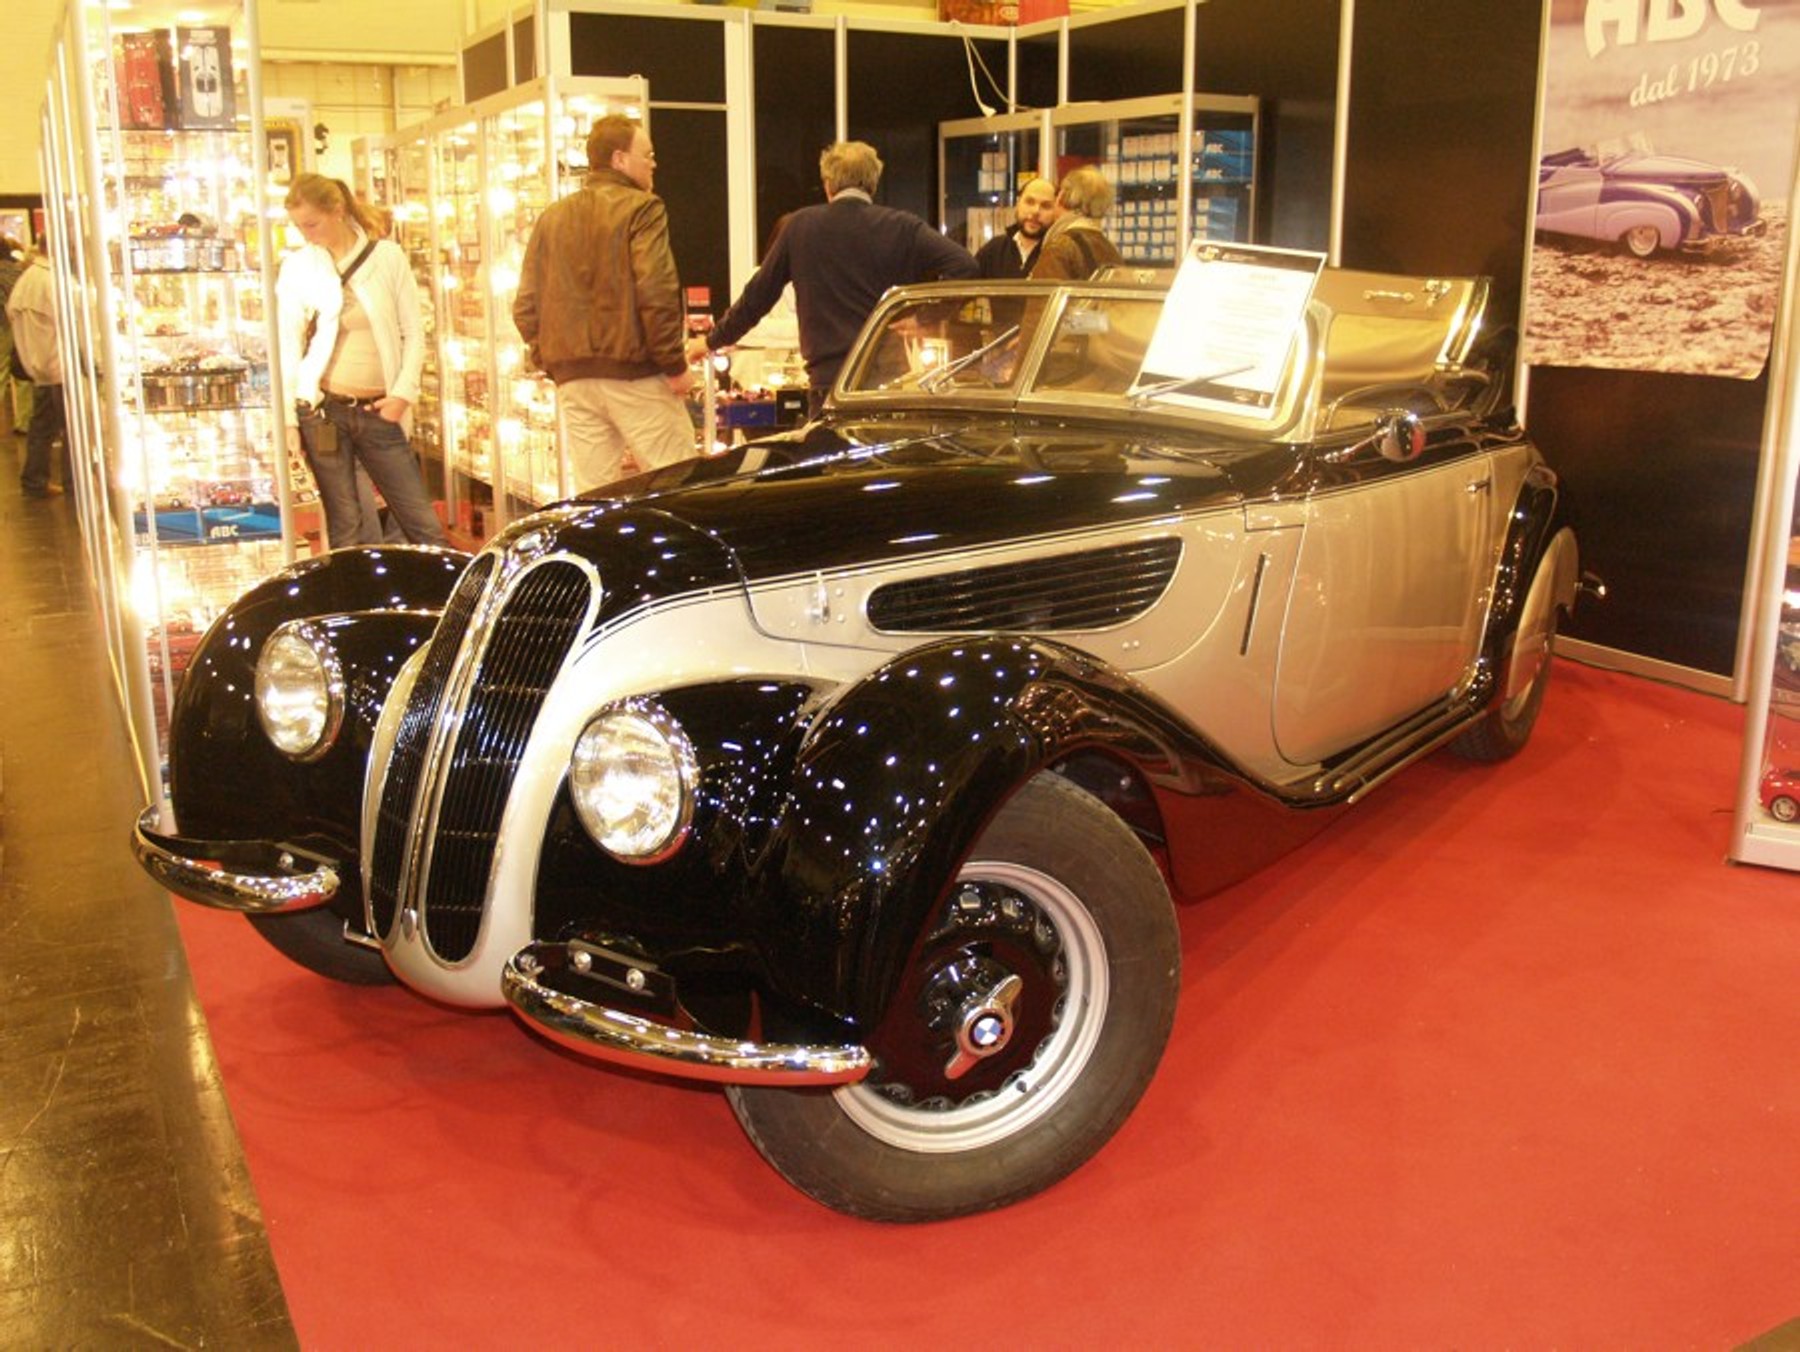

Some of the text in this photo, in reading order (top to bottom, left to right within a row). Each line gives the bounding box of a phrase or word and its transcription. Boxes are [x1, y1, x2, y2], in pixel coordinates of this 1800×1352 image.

[1629, 40, 1760, 107] dal 1973
[210, 524, 239, 539] ABC
